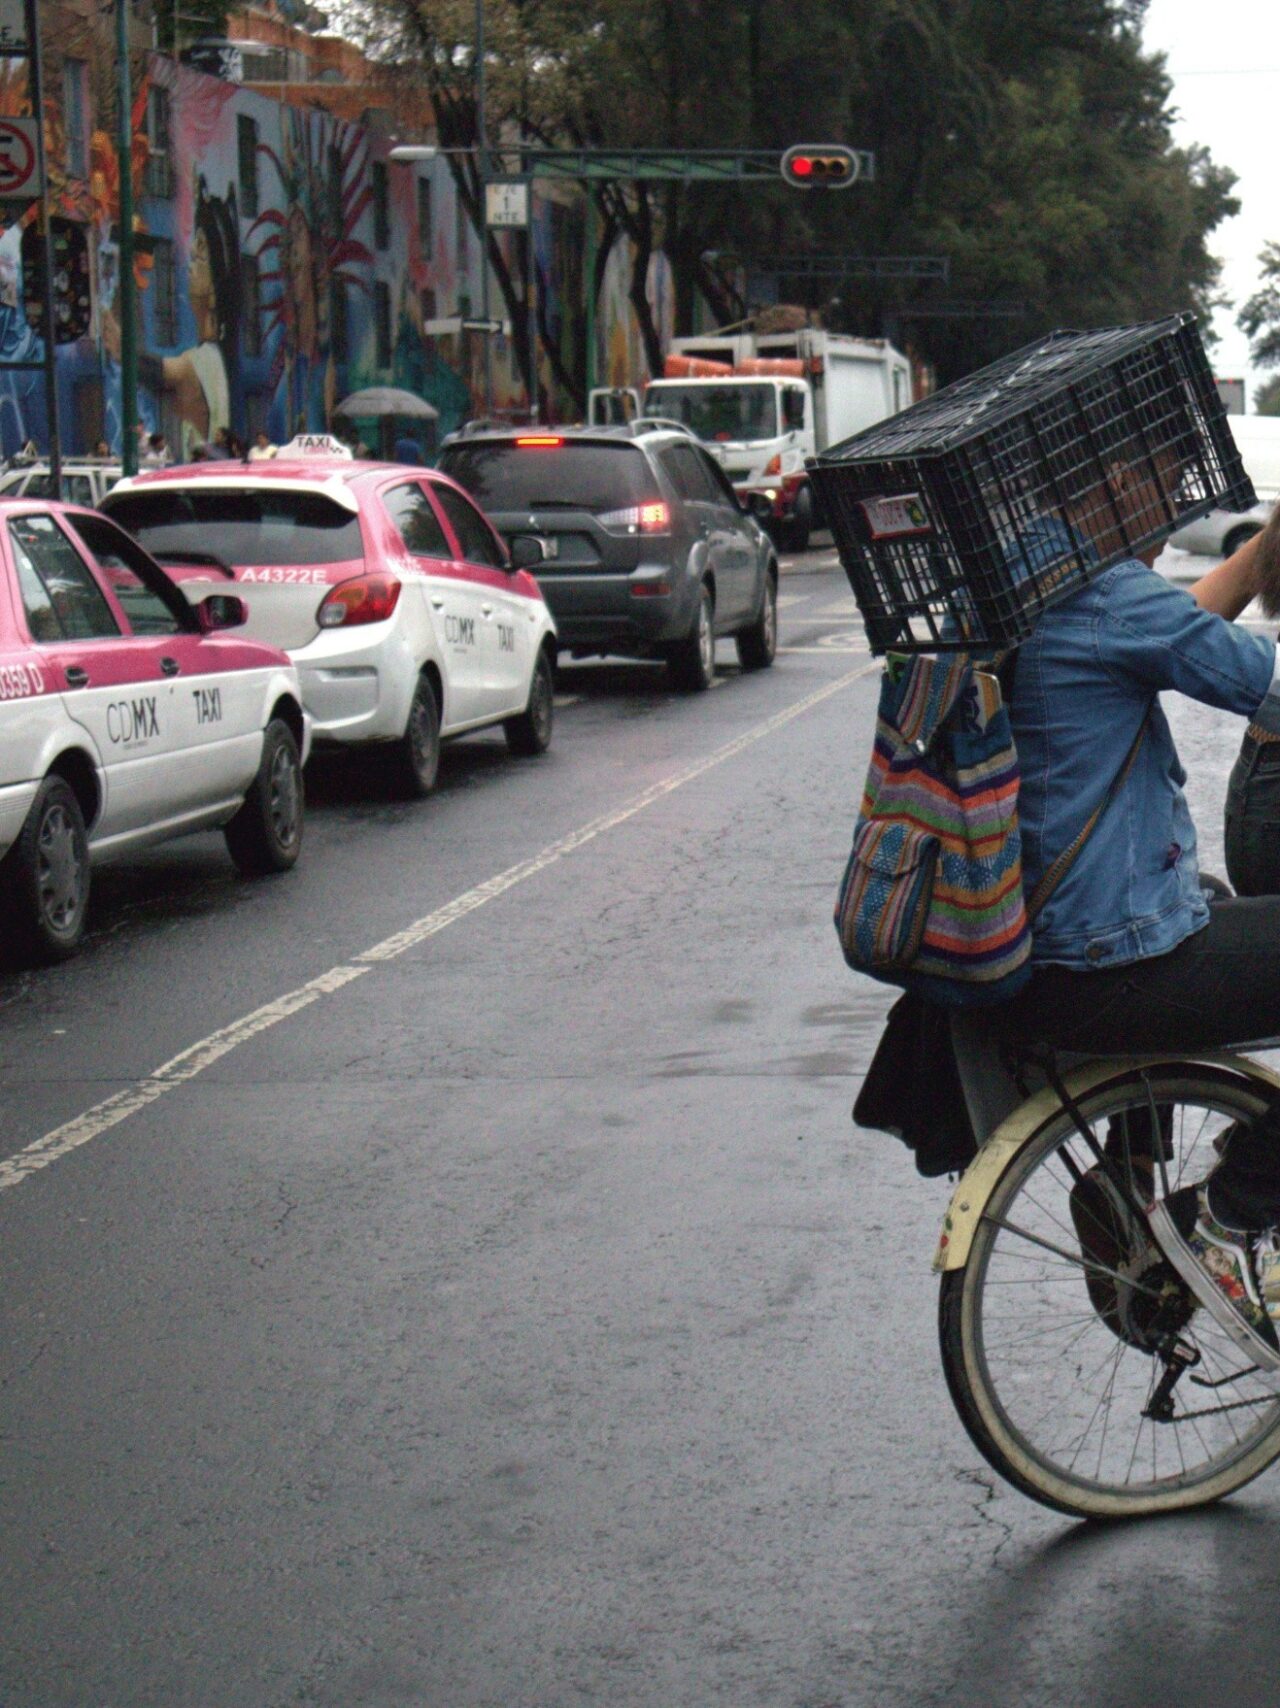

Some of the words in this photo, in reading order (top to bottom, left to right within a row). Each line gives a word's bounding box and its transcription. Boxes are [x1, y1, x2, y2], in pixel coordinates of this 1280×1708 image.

[296, 436, 330, 448] TAXI
[240, 569, 327, 584] A4322E
[445, 614, 475, 645] CDMX
[497, 623, 515, 652] TAXI
[106, 697, 160, 744] CDMX
[193, 687, 222, 724] TAXI
